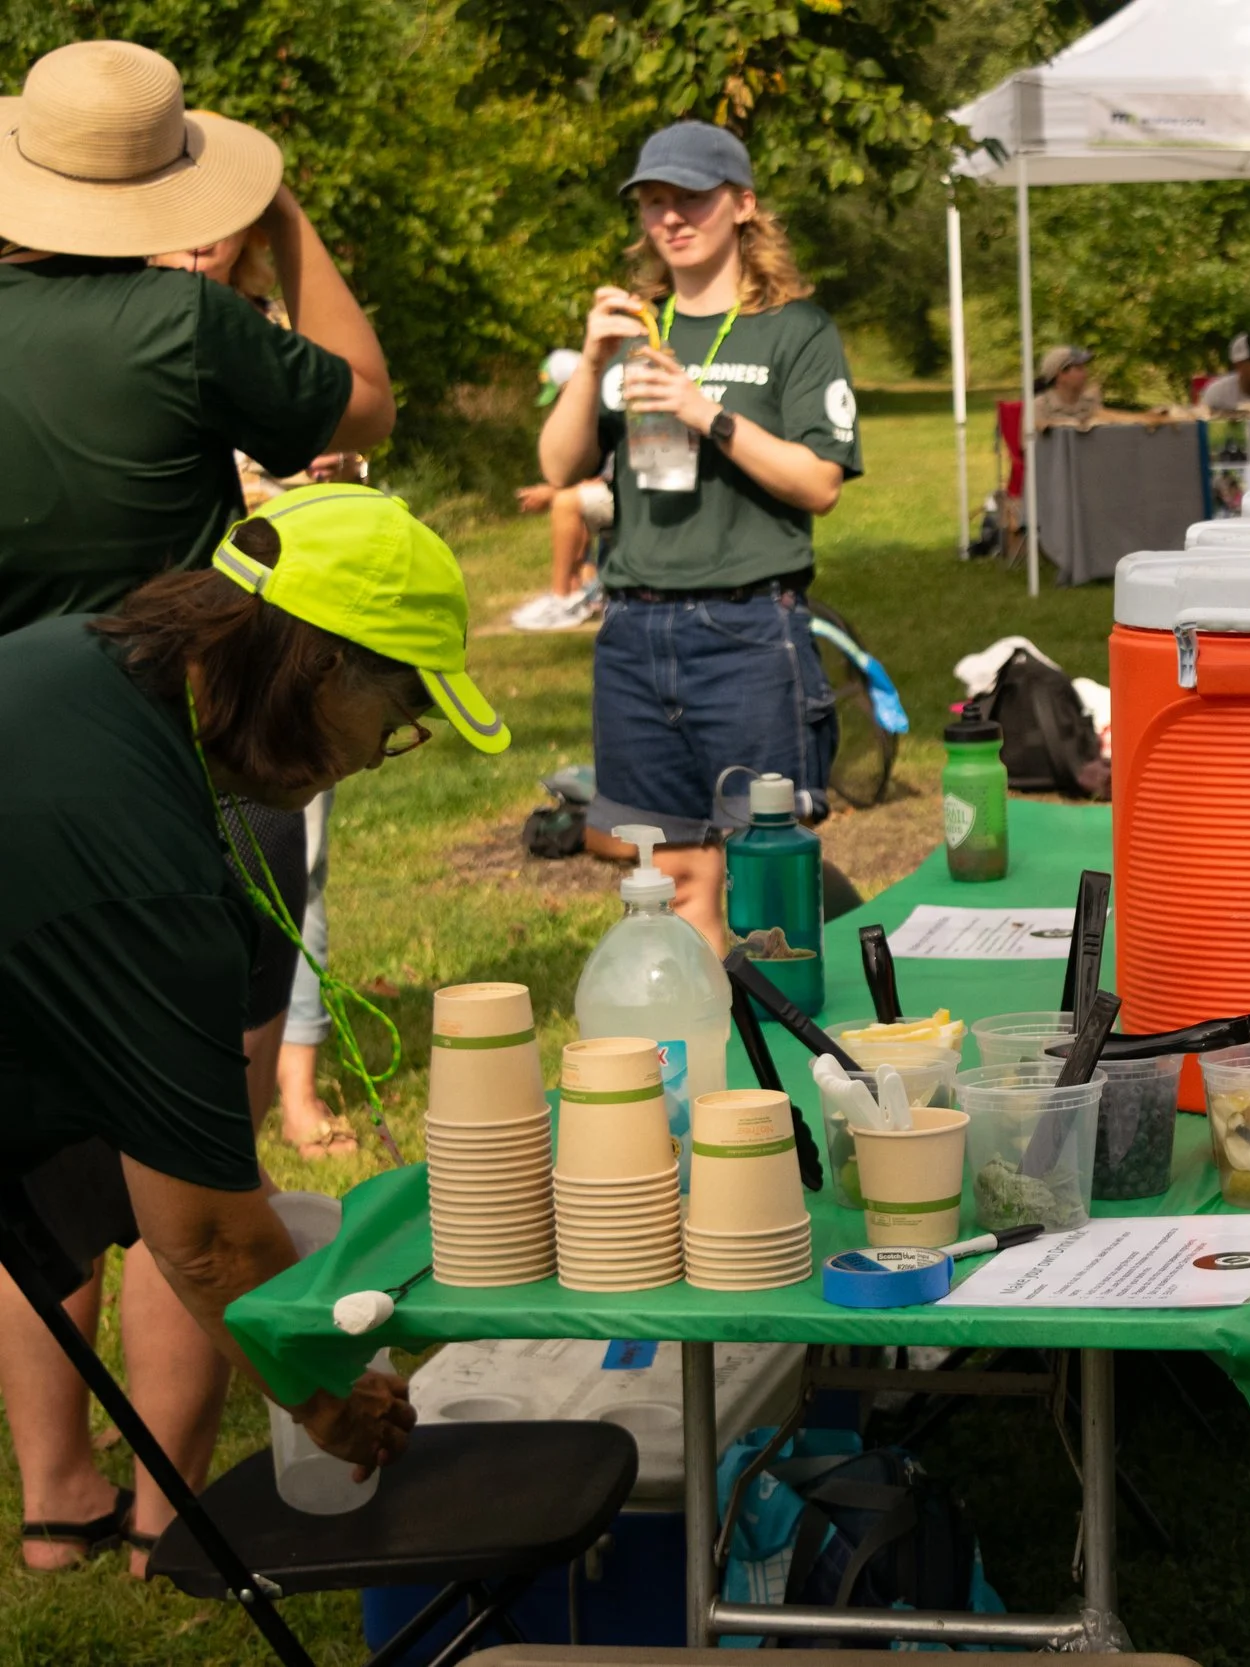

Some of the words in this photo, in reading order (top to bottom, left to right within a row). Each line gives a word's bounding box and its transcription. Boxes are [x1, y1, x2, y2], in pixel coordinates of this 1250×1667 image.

[878, 1252, 902, 1260] Scotch
[903, 1252, 916, 1260] blue
[1000, 1279, 1030, 1294] Make
[1022, 1268, 1043, 1279] your
[1037, 1254, 1059, 1266] own
[1048, 1241, 1074, 1253] Drink
